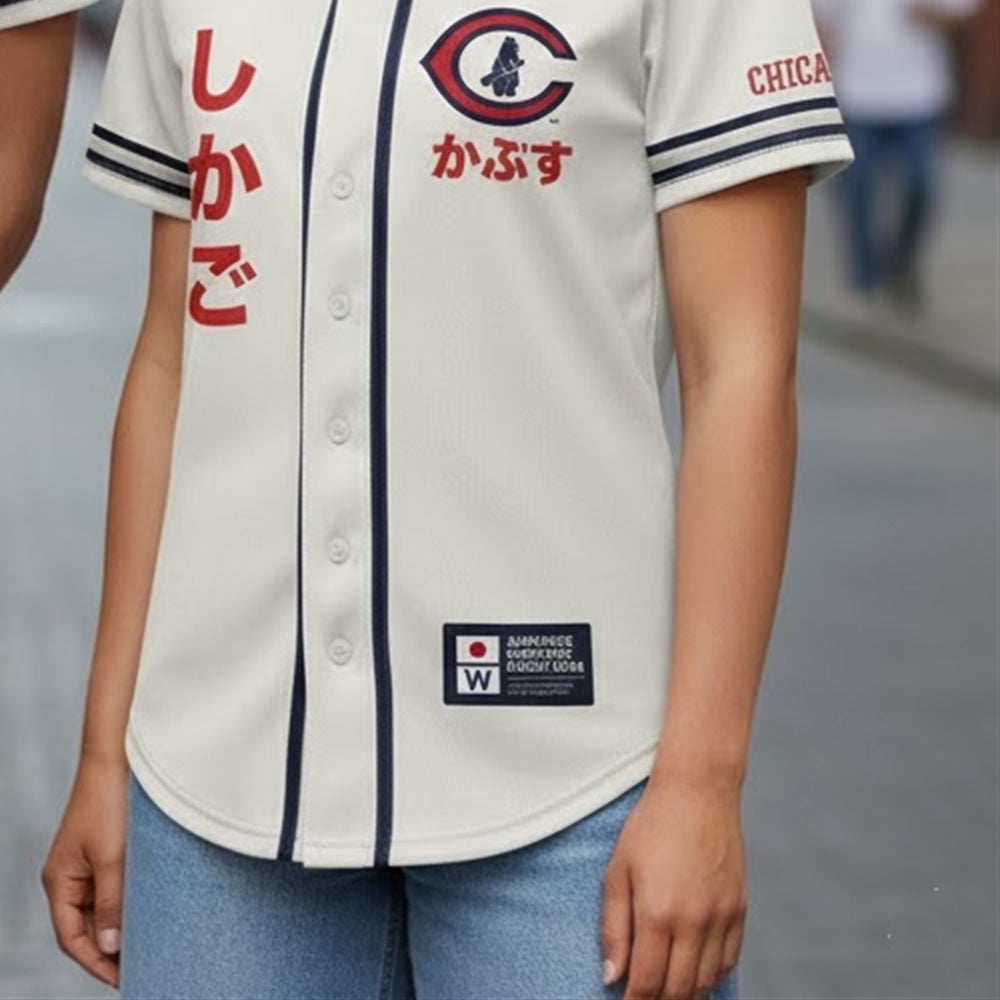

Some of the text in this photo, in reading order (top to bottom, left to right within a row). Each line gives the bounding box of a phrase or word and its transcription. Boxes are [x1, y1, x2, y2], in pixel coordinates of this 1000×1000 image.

[419, 7, 578, 127] C
[747, 52, 833, 96] CHICA
[188, 28, 263, 327] しかご
[431, 132, 574, 187] かぶす
[463, 668, 493, 692] W
